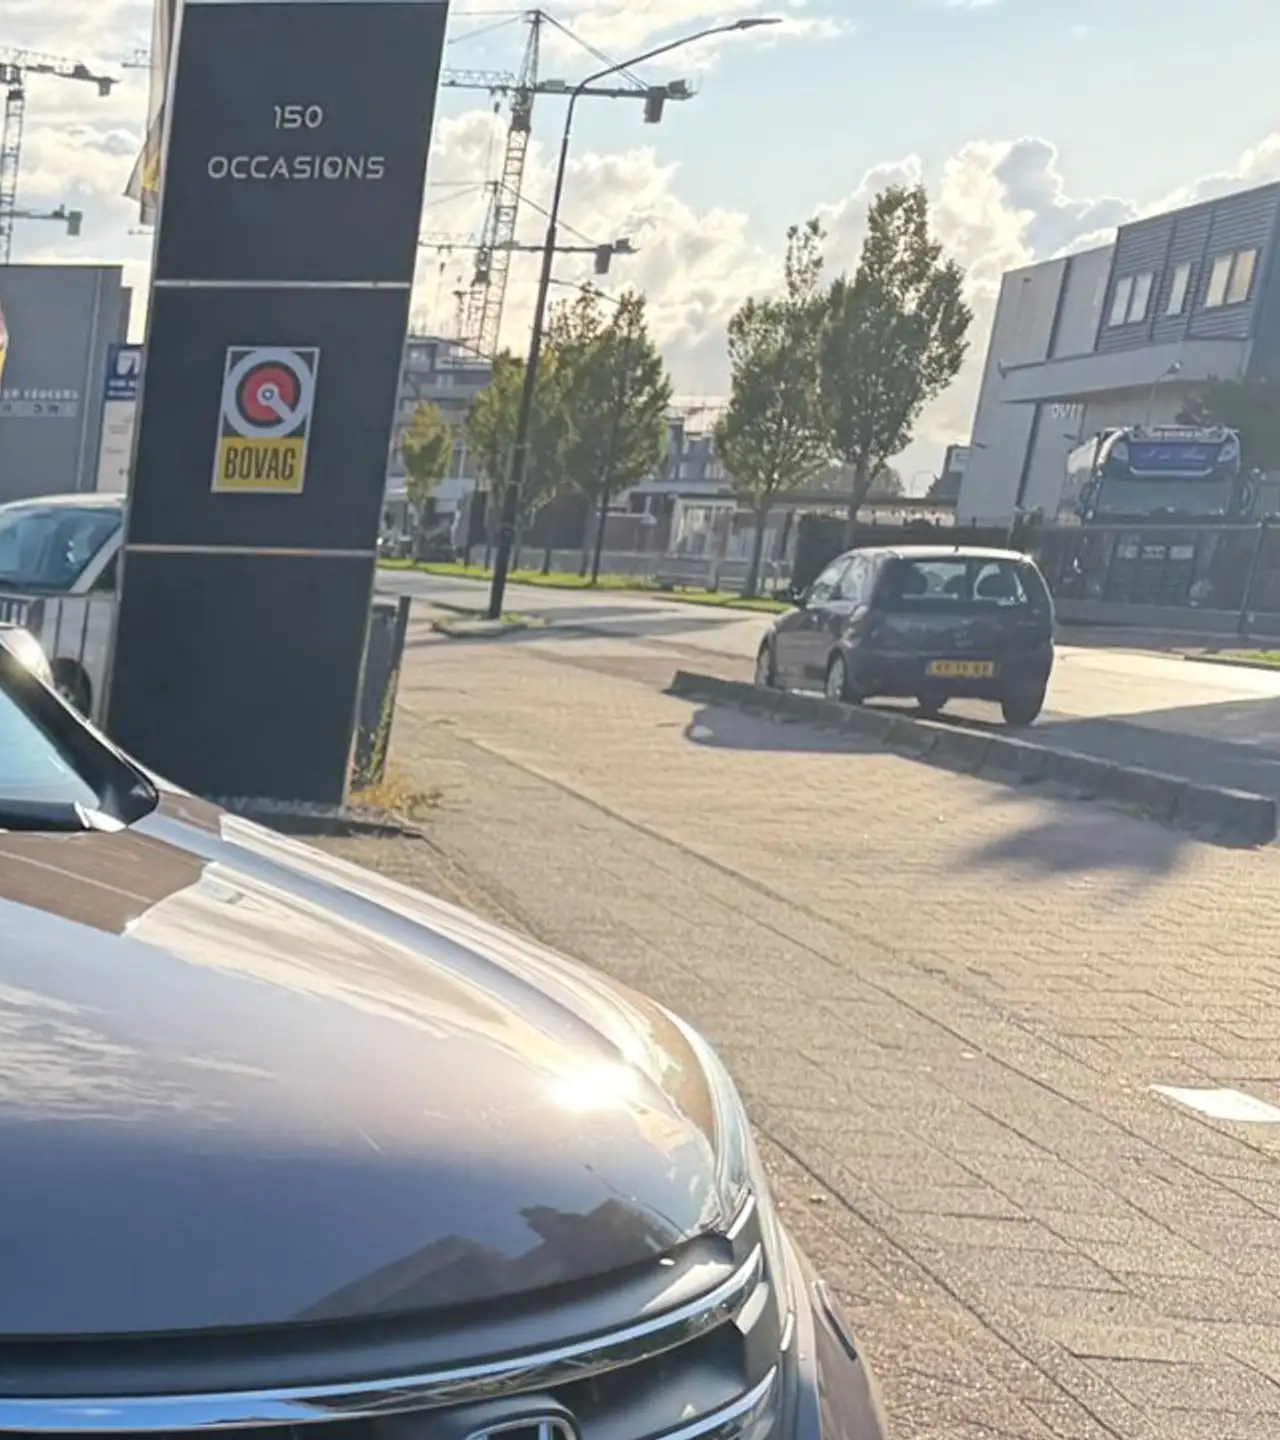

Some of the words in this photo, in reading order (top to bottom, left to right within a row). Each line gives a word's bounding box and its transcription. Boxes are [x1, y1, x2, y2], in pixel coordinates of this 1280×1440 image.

[273, 104, 324, 129] 150
[207, 155, 386, 180] OCCASIONS
[223, 445, 296, 481] BOVAG
